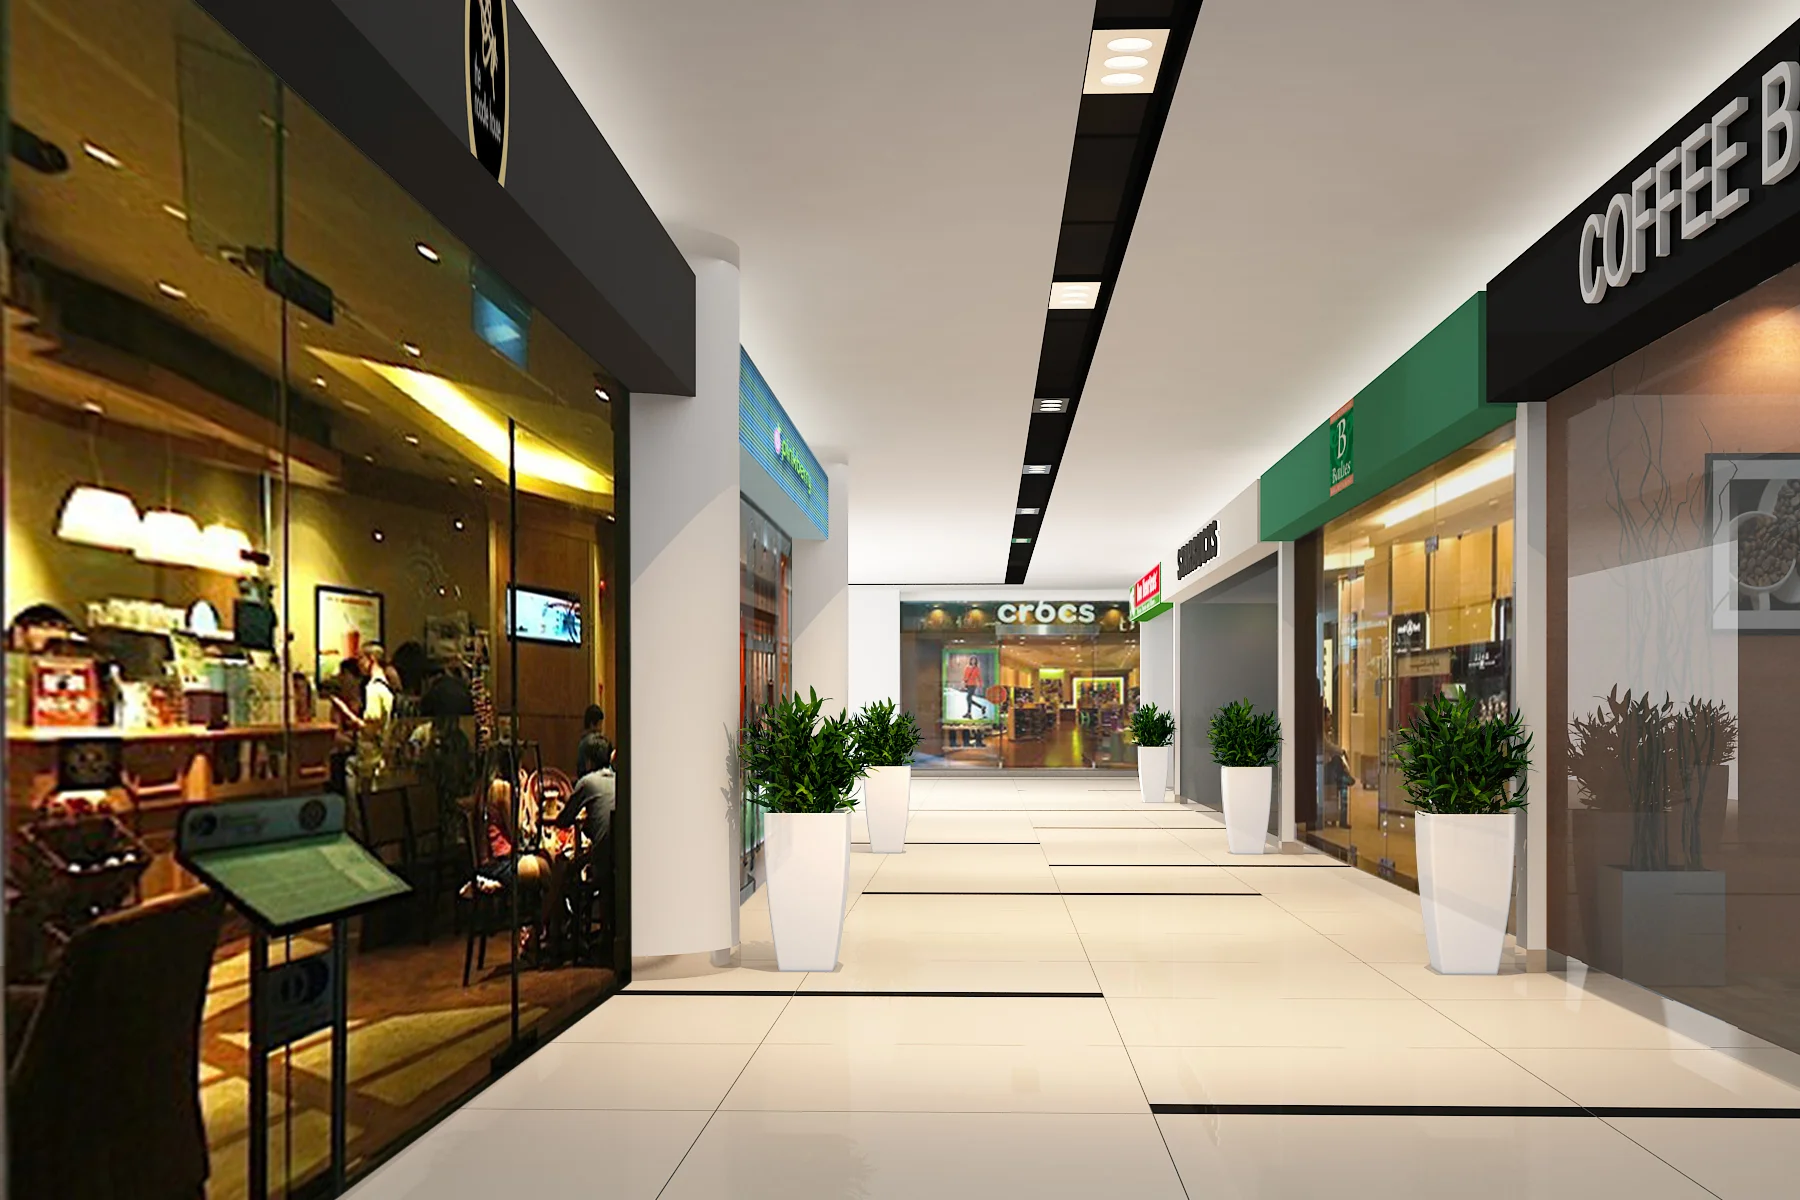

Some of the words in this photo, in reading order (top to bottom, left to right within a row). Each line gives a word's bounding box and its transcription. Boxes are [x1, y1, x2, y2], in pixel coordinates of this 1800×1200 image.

[1578, 96, 1749, 304] COFFEE
[1337, 418, 1347, 459] B
[997, 600, 1095, 623] crocs
